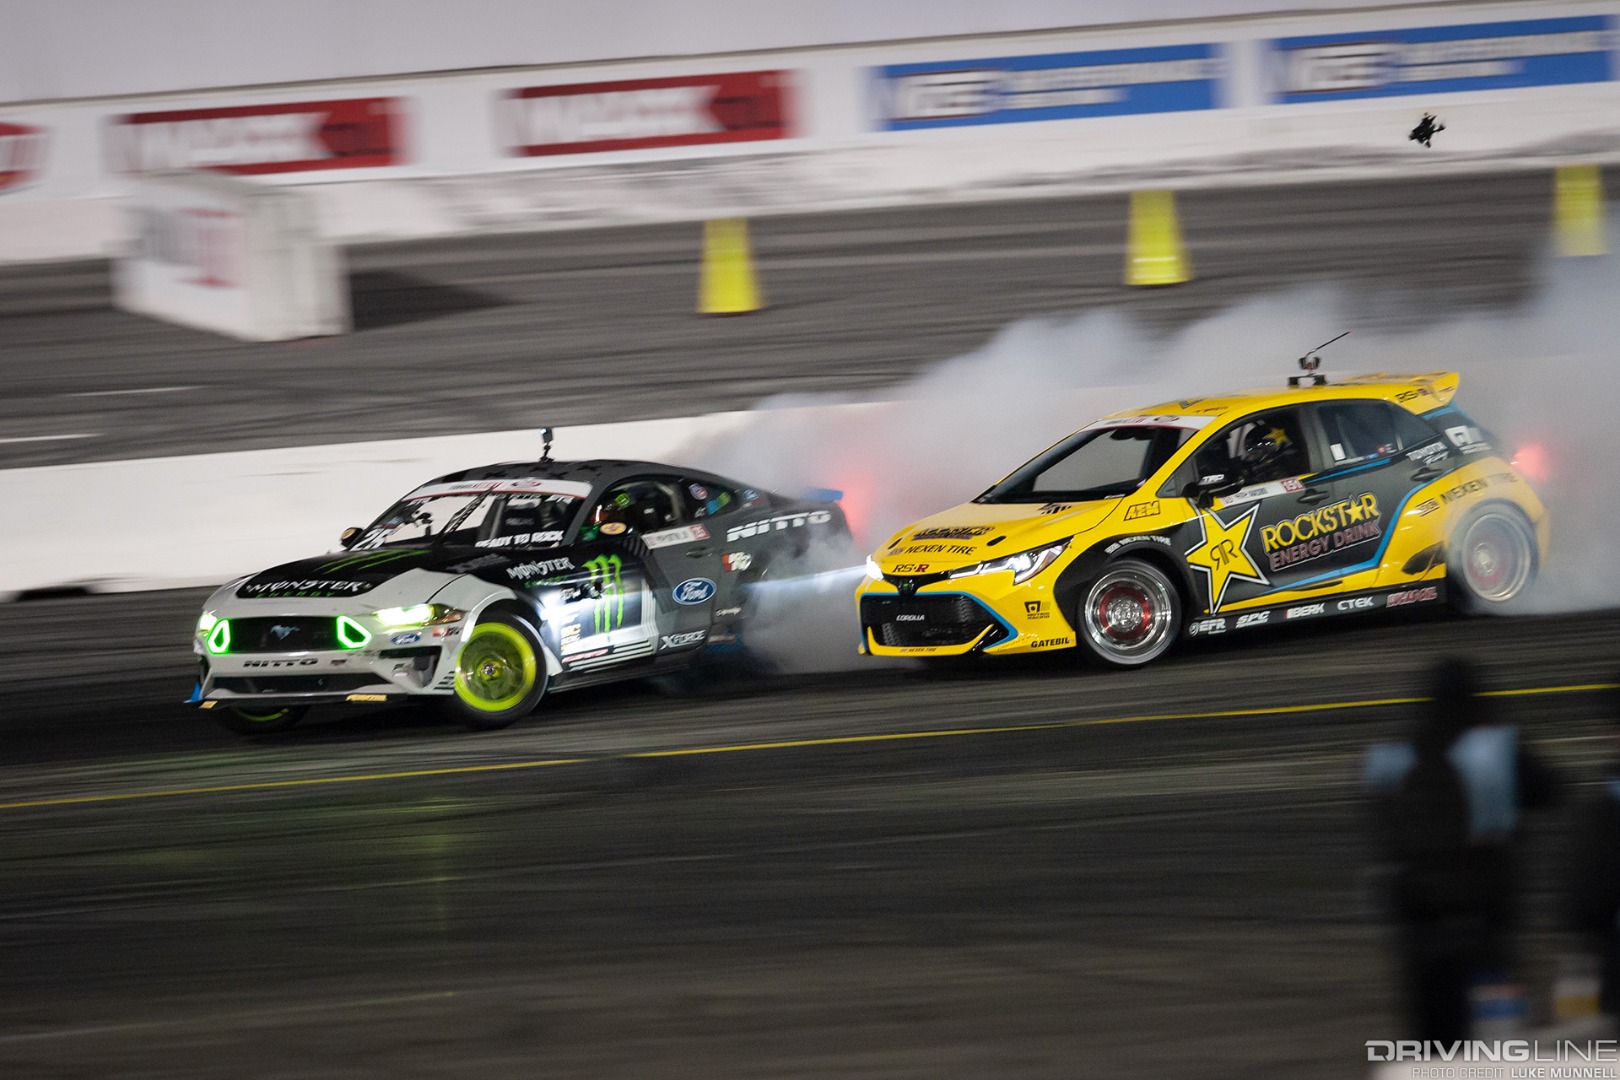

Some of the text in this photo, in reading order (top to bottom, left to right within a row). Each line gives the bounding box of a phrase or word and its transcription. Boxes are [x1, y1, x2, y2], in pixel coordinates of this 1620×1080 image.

[1440, 479, 1488, 505] NEXEN
[726, 510, 832, 542] NITTO
[1261, 492, 1380, 552] ROCKSTAR
[904, 545, 946, 554] NEXEN
[947, 545, 978, 555] TIRE
[1270, 520, 1379, 569] ENERGY DRINK
[506, 557, 575, 580] MONSTER
[246, 579, 364, 592] MONSTER
[1337, 596, 1375, 611] CTEK
[896, 614, 925, 622] COROLLA
[1199, 617, 1227, 632] EFR
[1237, 611, 1271, 625] SPC
[1030, 637, 1071, 648] GATEBIL
[242, 657, 319, 668] NITTO
